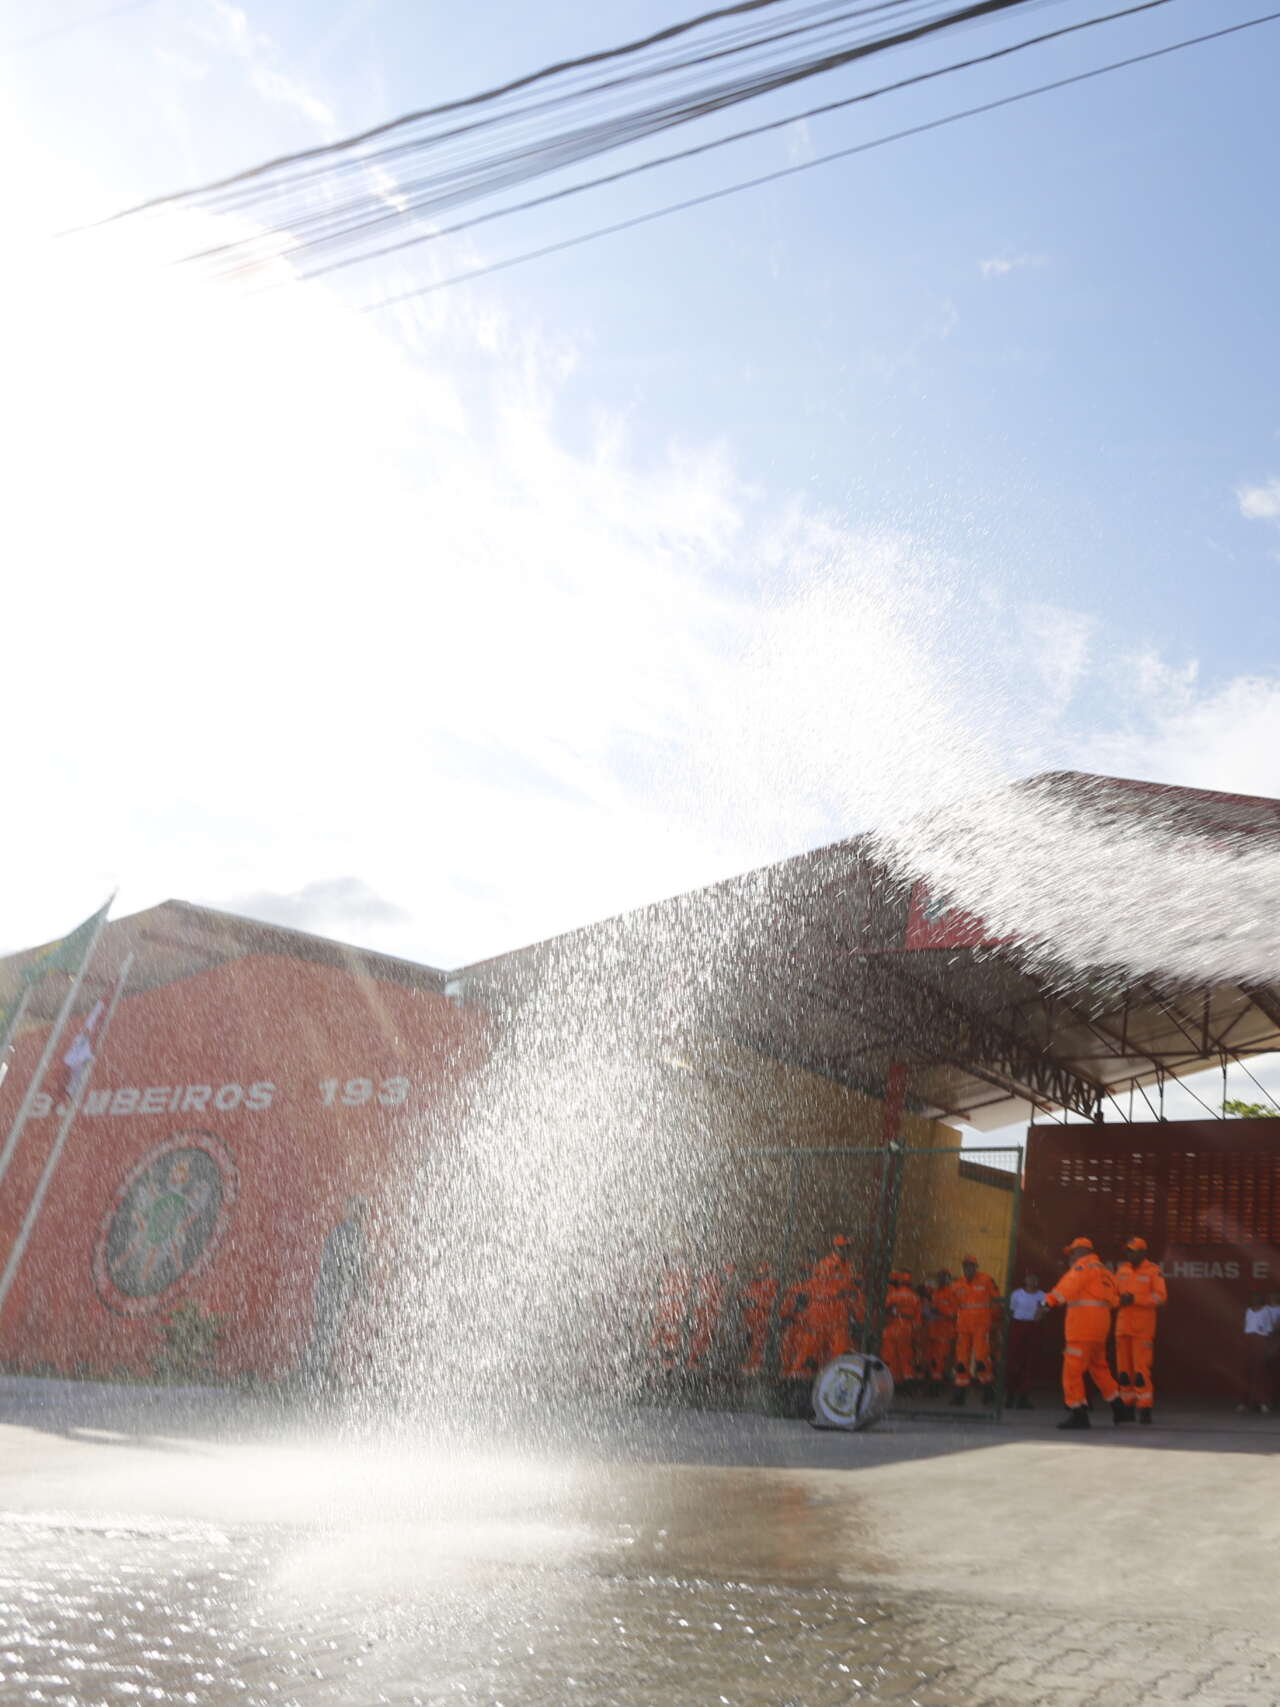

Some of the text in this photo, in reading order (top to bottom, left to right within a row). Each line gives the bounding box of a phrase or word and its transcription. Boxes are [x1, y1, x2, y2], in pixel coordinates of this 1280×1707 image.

[320, 1076, 409, 1106] 193
[1160, 1261, 1239, 1279] LHEIAS
[1253, 1262, 1270, 1279] E
